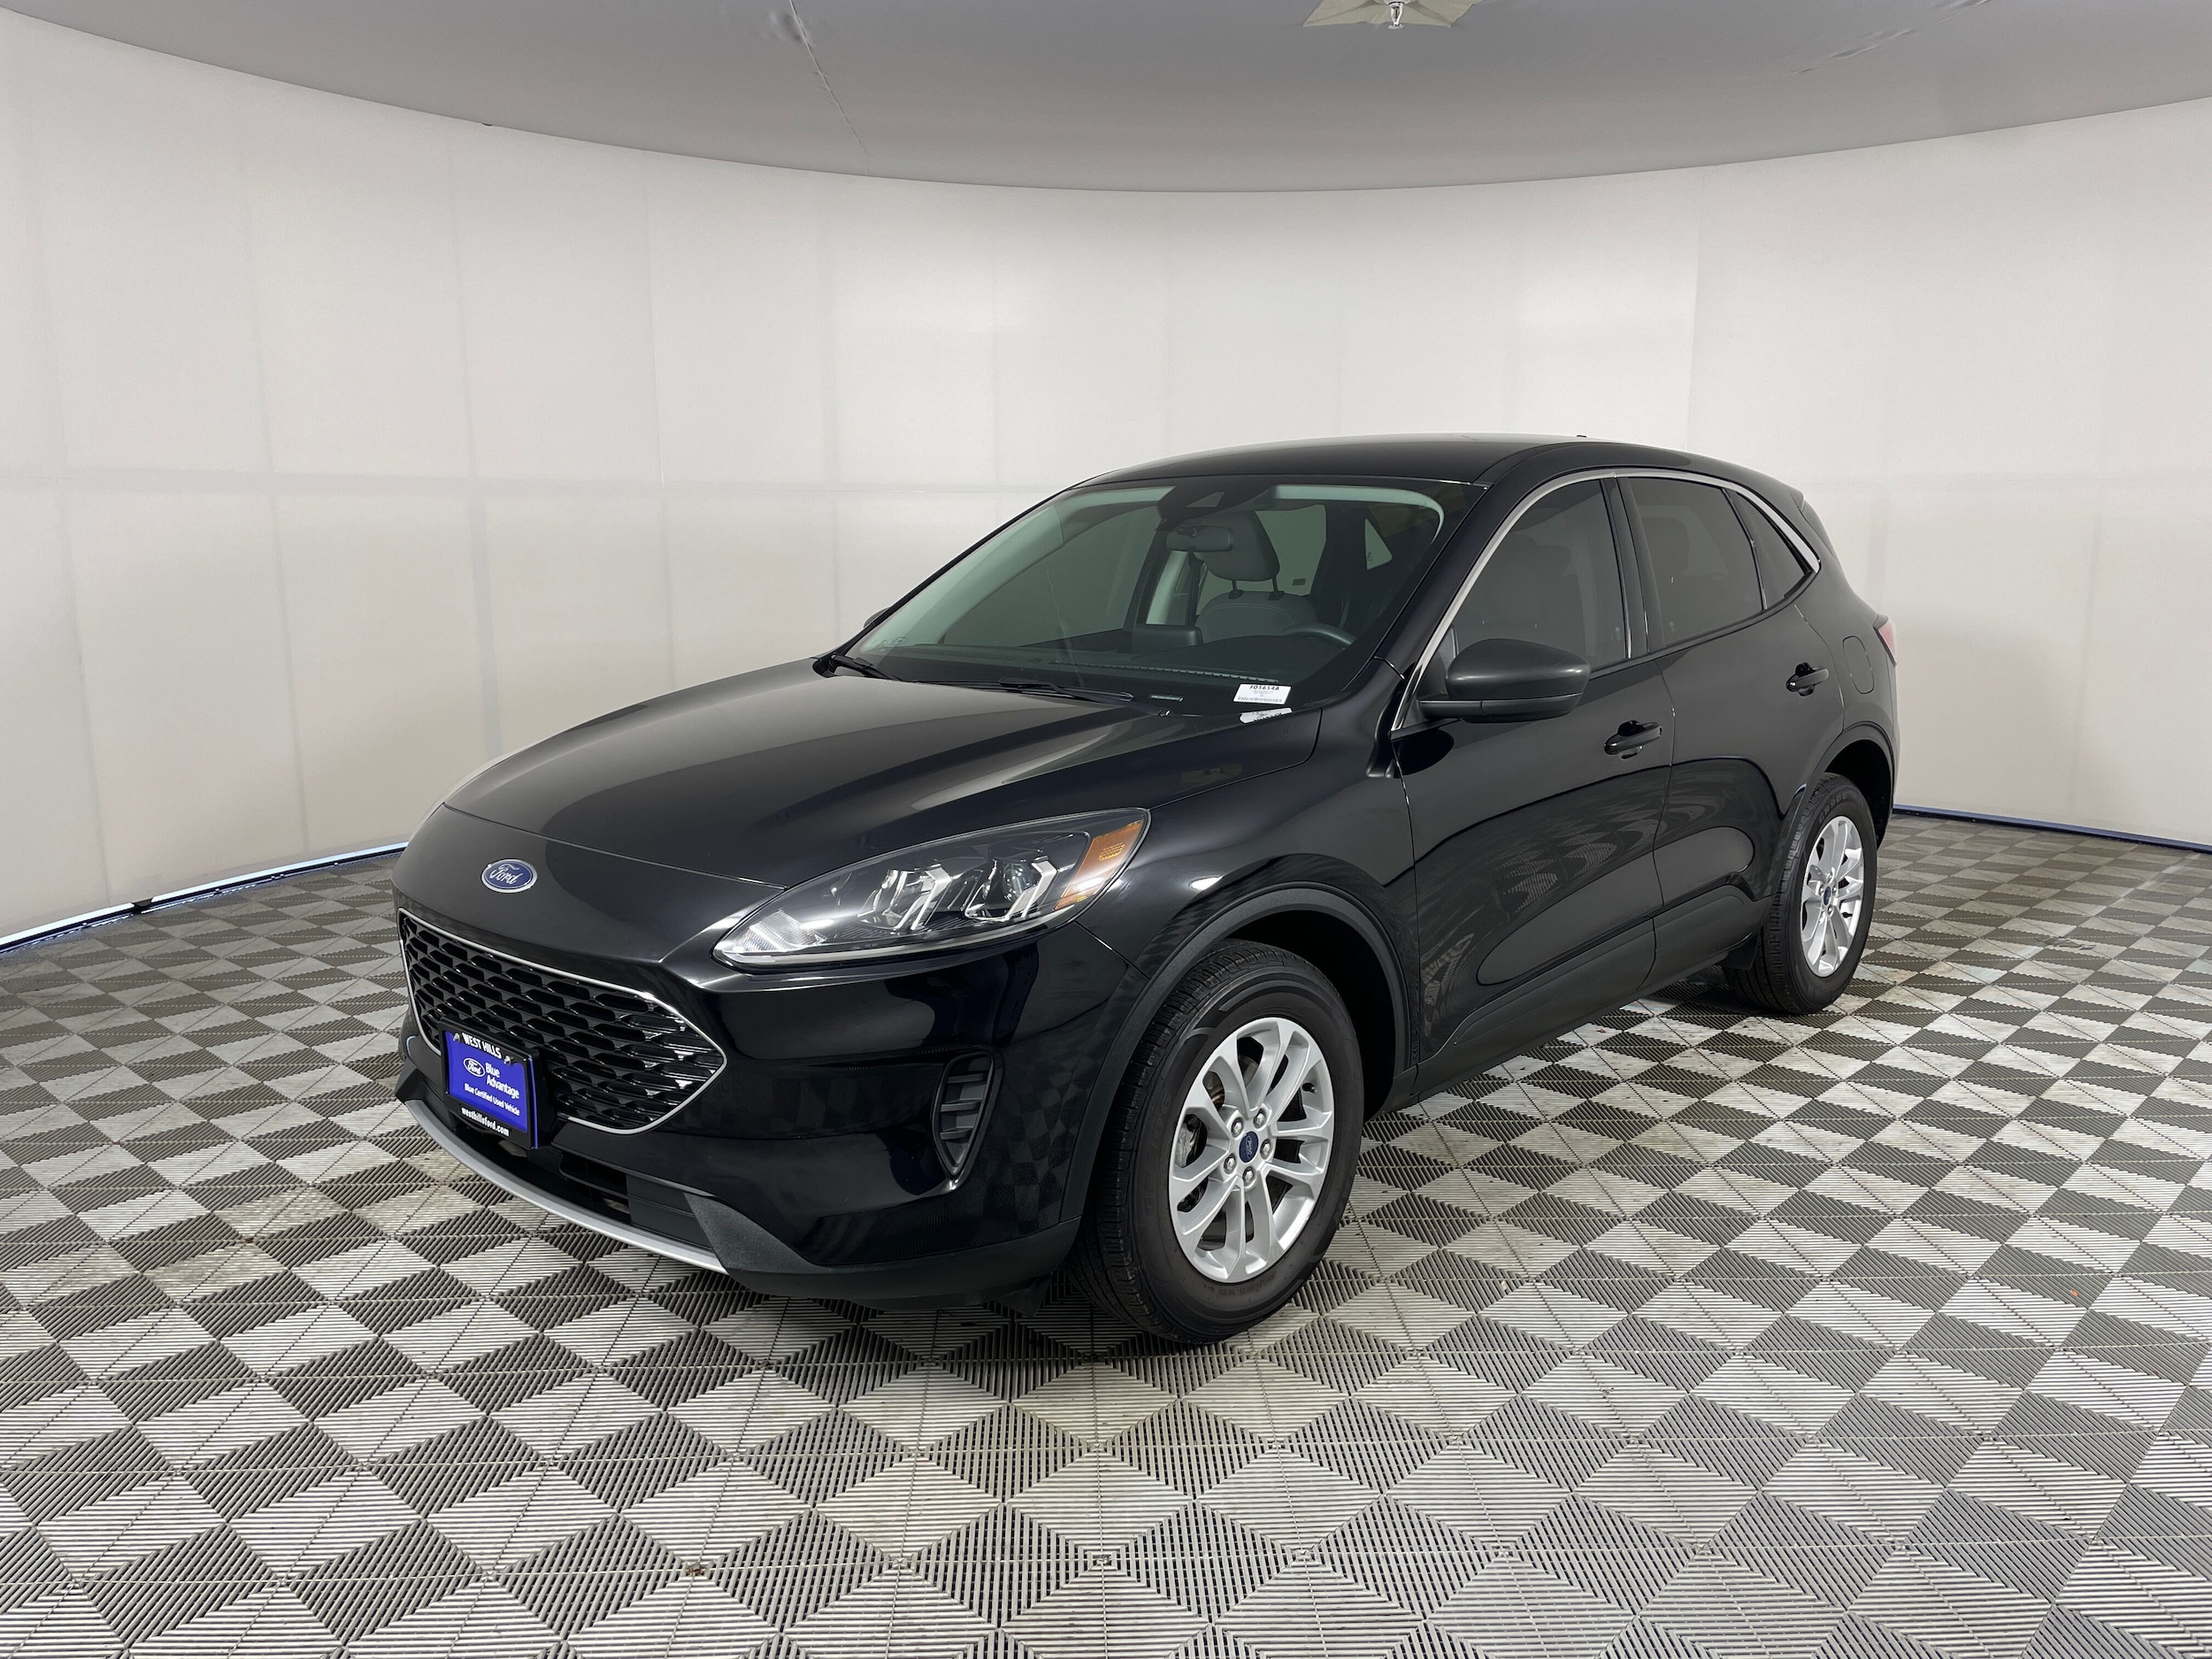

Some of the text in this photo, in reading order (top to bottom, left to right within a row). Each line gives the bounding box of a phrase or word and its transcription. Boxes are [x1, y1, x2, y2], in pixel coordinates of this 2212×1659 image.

[489, 864, 524, 885] Ford
[461, 1032, 503, 1059] WEST HILLS
[466, 1059, 482, 1076] Ford
[485, 1061, 500, 1078] Blue
[464, 1082, 520, 1116] Blue Certified Used Vehicle
[487, 1074, 520, 1099] Advantage
[461, 1107, 510, 1137] westhillsford.com
